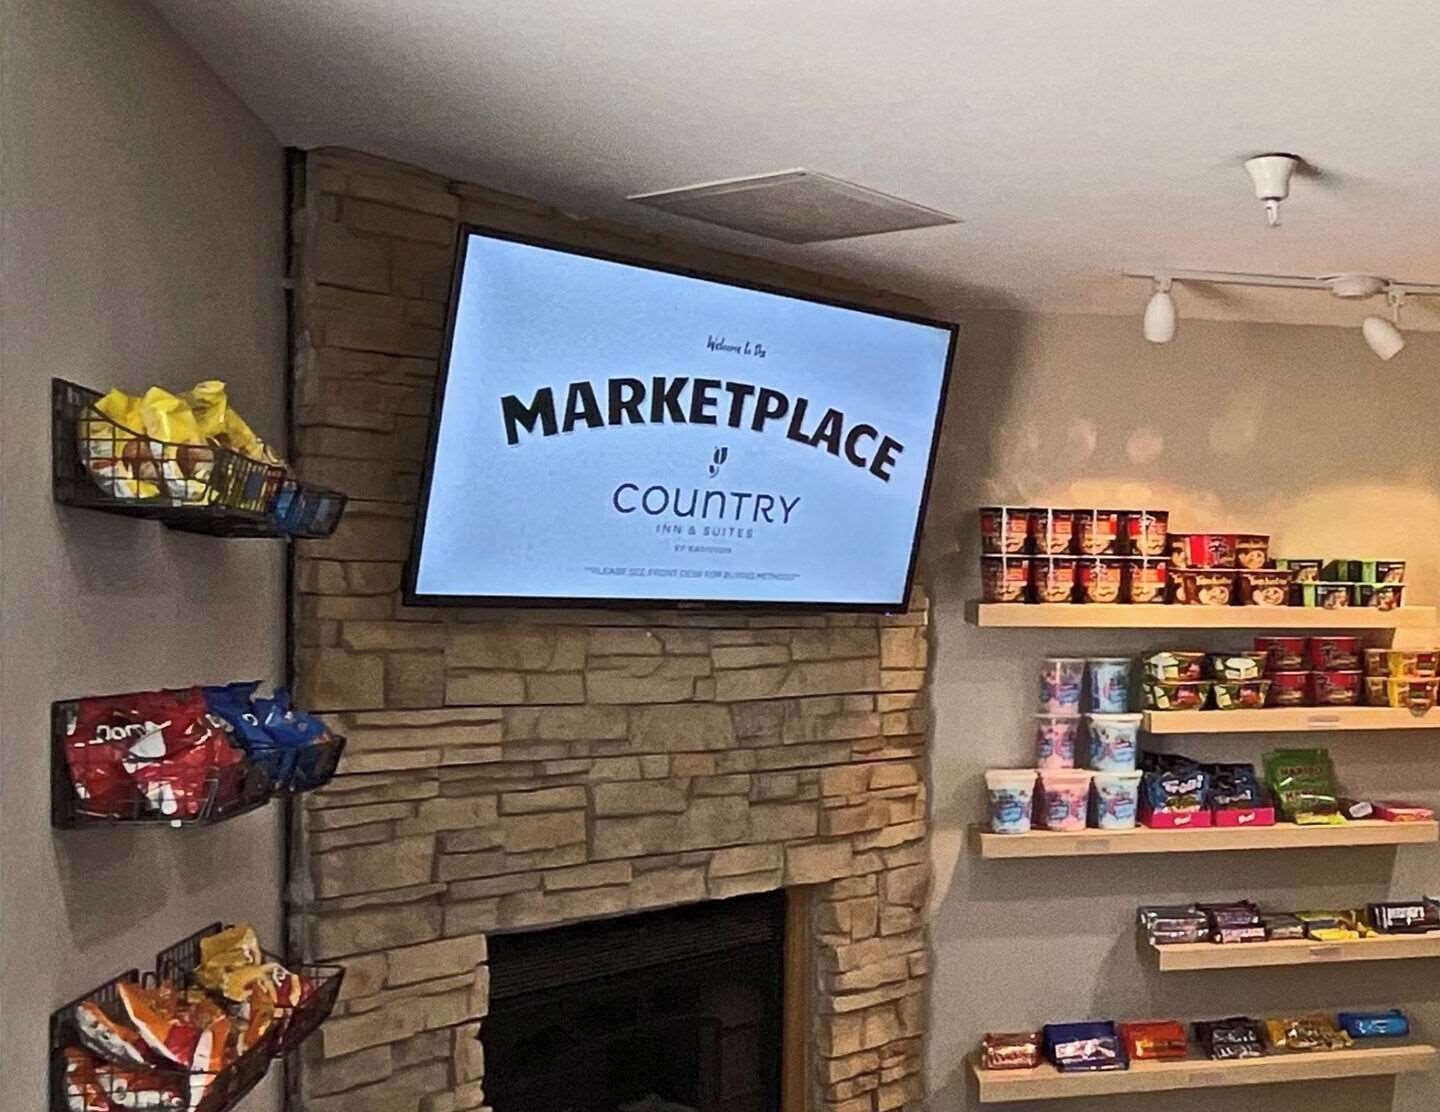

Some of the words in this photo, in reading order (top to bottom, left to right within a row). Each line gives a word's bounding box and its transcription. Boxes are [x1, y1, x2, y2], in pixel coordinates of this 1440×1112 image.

[501, 376, 905, 483] MARKETPLACE
[656, 524, 682, 535] INN
[703, 526, 753, 539] SUITES
